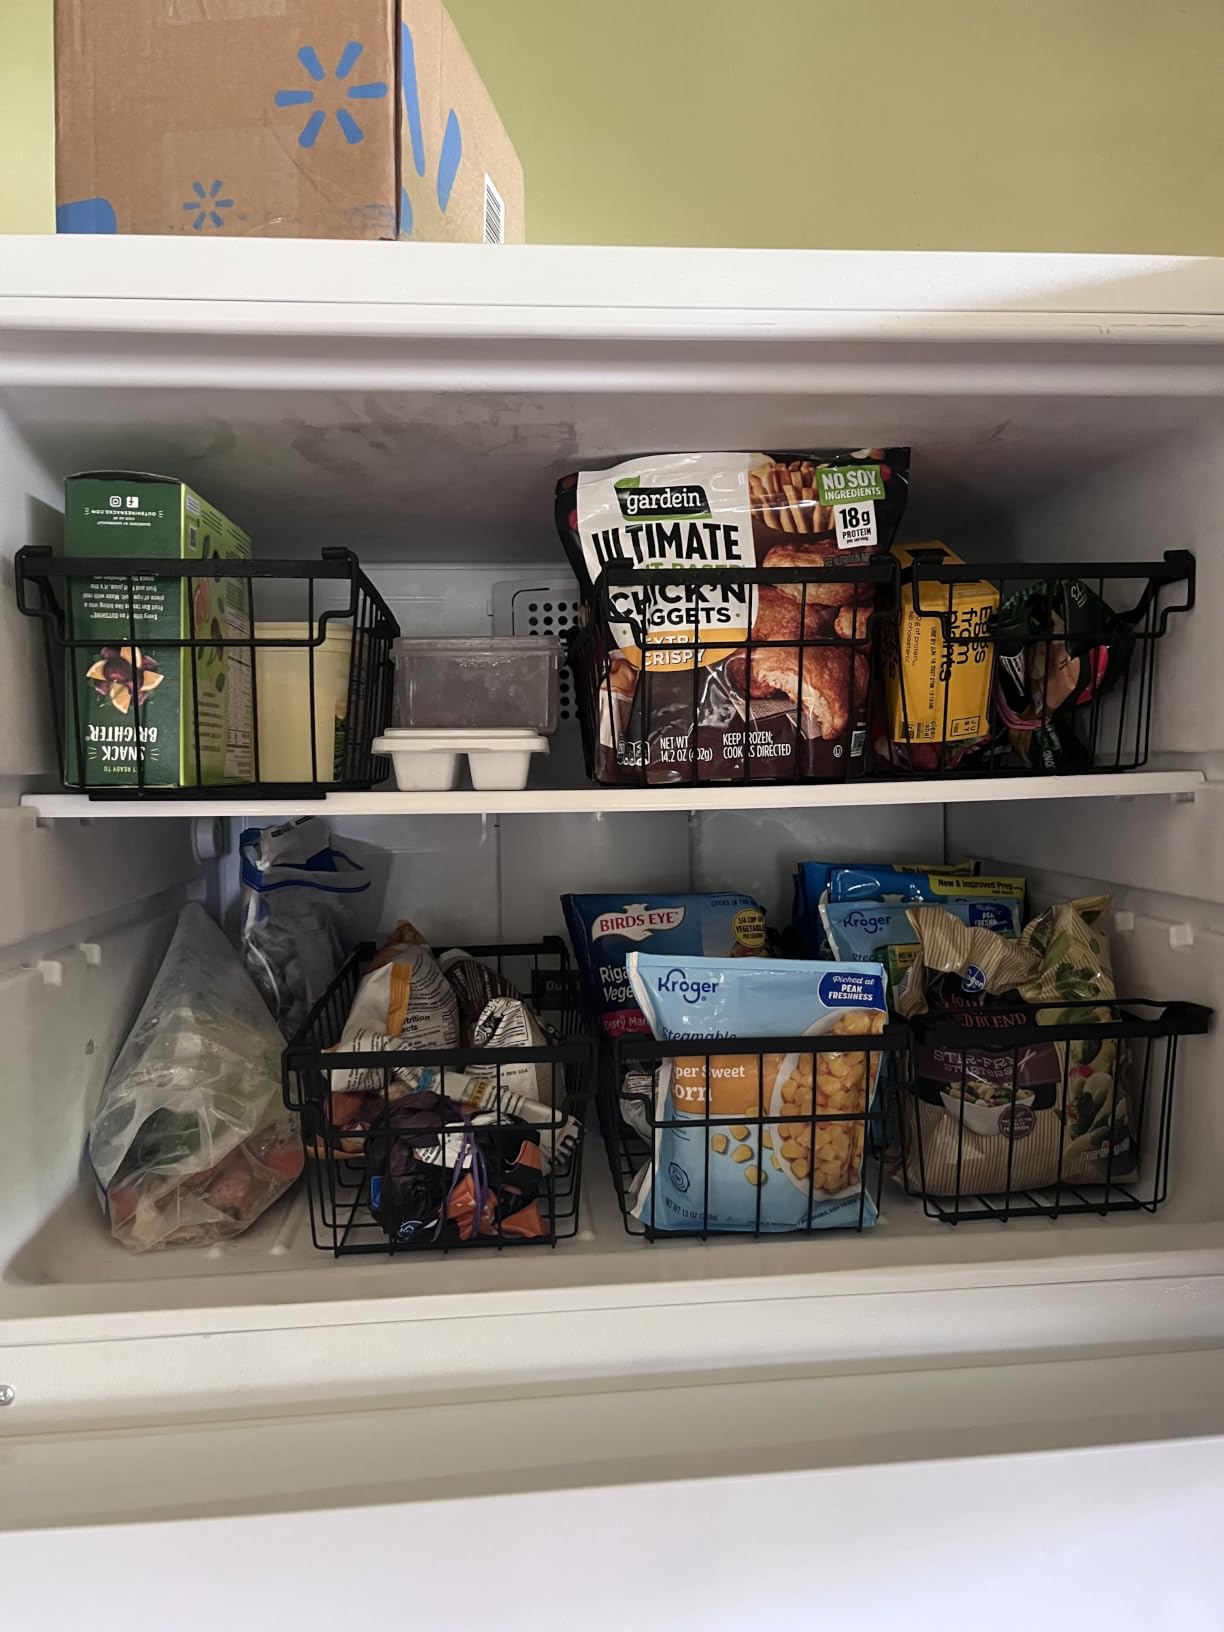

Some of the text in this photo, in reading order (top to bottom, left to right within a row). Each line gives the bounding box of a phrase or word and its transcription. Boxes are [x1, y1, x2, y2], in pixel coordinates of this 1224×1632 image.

[822, 470, 876, 490] NO SOY
[626, 488, 702, 515] gardein
[825, 487, 881, 500] INGREDIENTS
[842, 527, 871, 539] PROTEIN
[592, 522, 742, 564] ULTIMATE
[641, 607, 732, 627] GGETS
[957, 608, 977, 664] from
[973, 606, 993, 663] Eggs
[645, 649, 707, 666] CRISPY
[660, 736, 689, 750] NET WT
[723, 733, 741, 745] KEEP
[101, 745, 146, 760] SNACK
[660, 750, 676, 762] 14.2
[677, 749, 687, 761] OZ
[723, 745, 743, 759] COOK
[757, 743, 792, 757] DIRECTED
[600, 912, 675, 932] BIRDS EYE
[843, 912, 891, 934] Kroger
[600, 966, 628, 984] Riga
[832, 975, 864, 985] Picked
[658, 968, 719, 1004] Kroger
[841, 984, 863, 993] PEAK
[603, 987, 634, 1003] Vege
[828, 991, 874, 1001] FRESHNESS
[976, 1012, 1026, 1028] BLEND
[662, 1027, 737, 1041] Steamable
[934, 1049, 1015, 1070] STIR-FRY
[675, 1065, 700, 1080] per
[674, 1083, 713, 1102] orn
